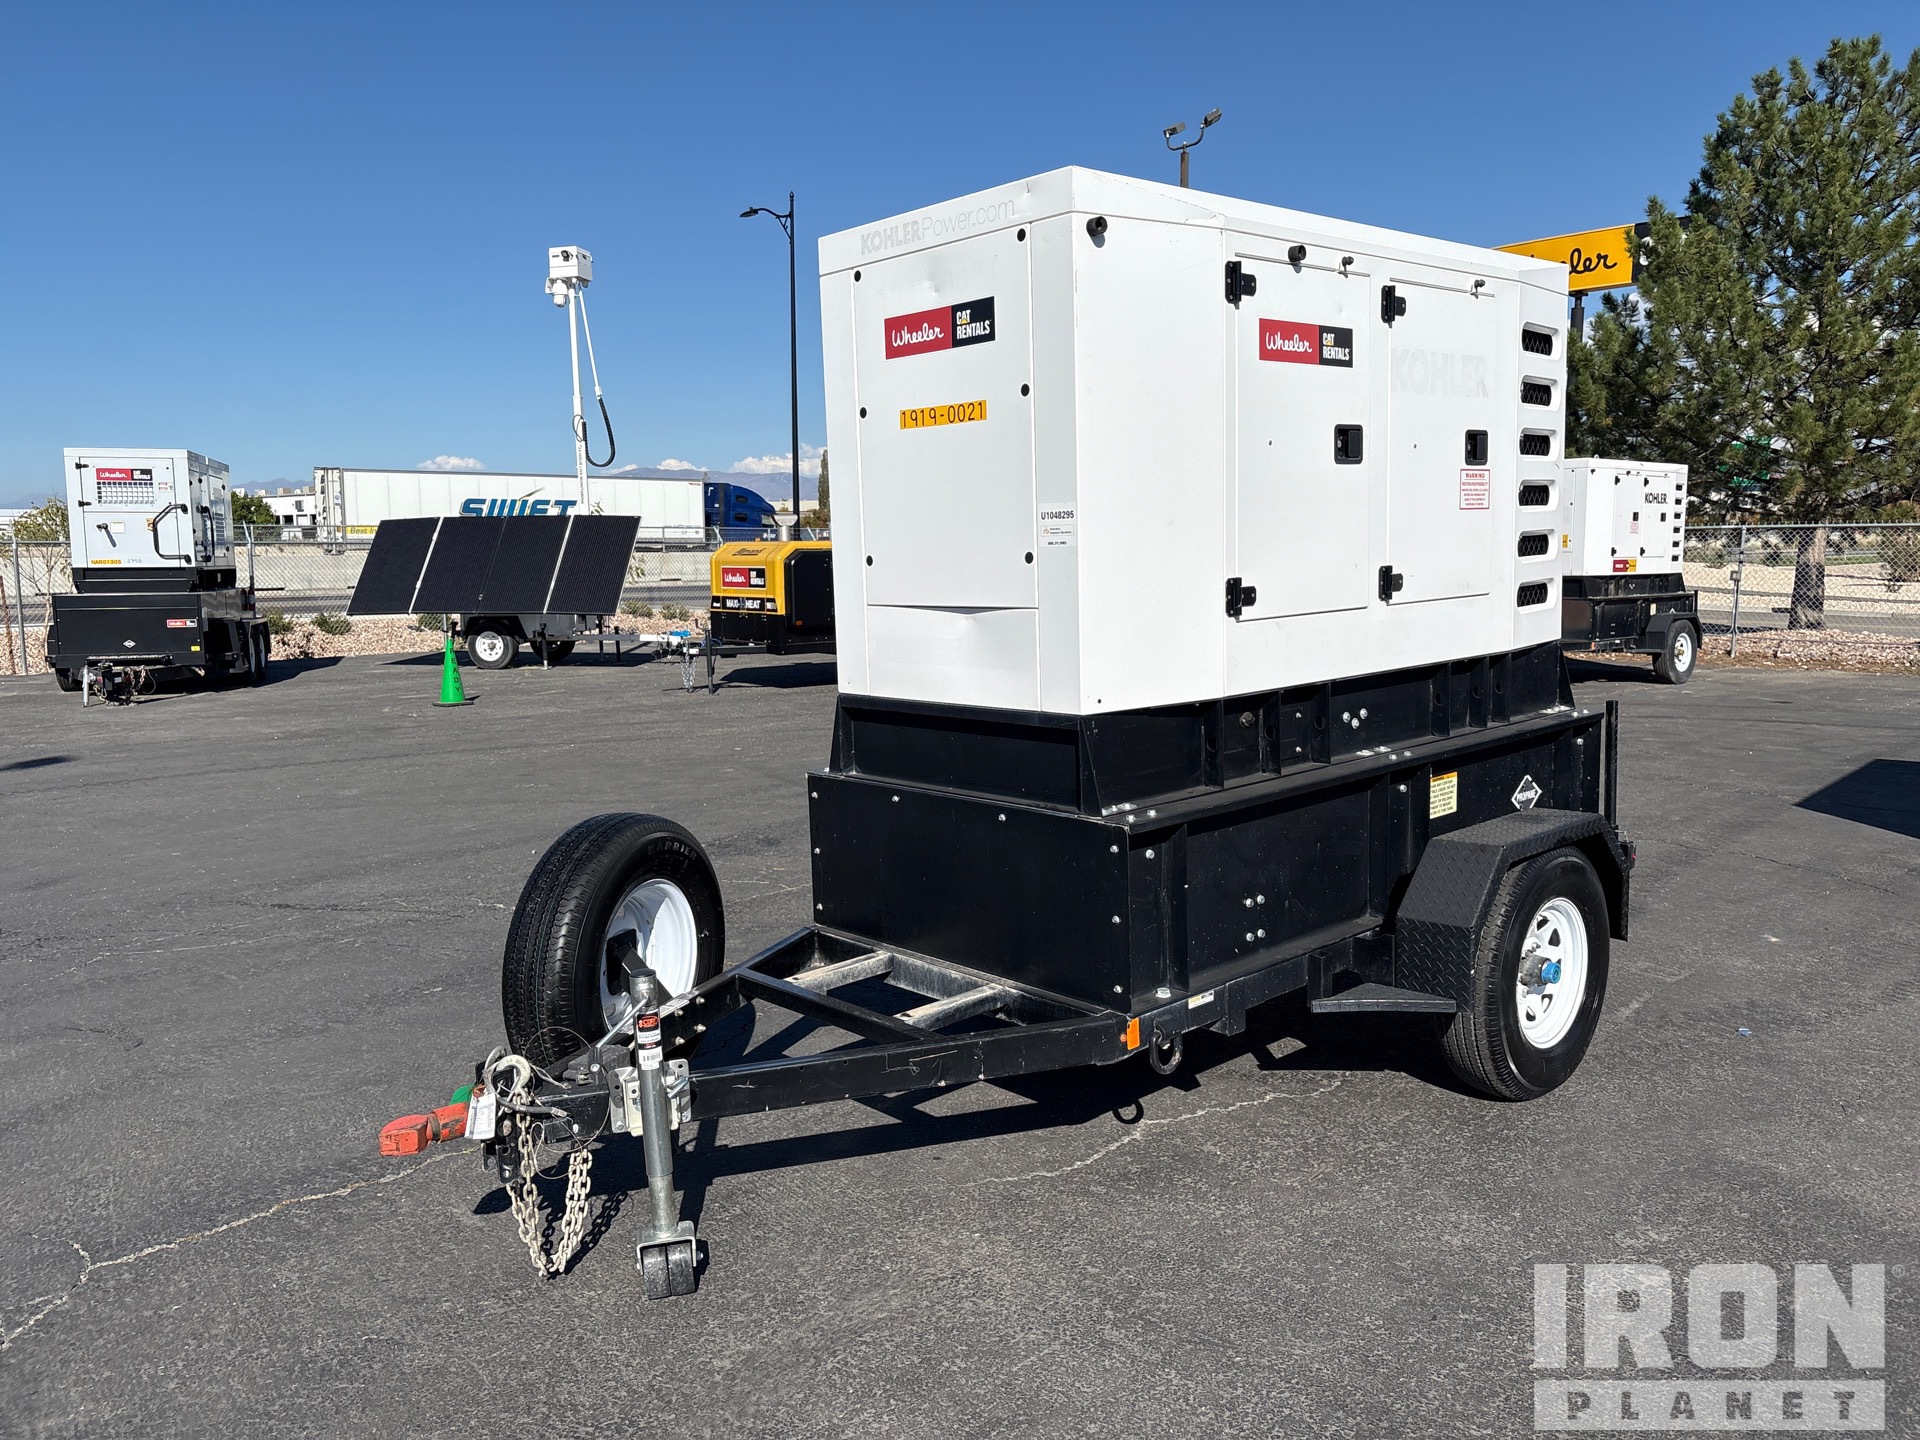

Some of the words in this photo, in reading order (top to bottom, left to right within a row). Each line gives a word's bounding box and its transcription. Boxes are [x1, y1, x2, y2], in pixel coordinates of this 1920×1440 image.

[860, 199, 1015, 256] KOHLERPower.com
[956, 309, 971, 325] CAT
[892, 321, 945, 348] Wheeler
[956, 319, 991, 340] RENTALS
[1265, 330, 1313, 353] Wheeler
[1322, 333, 1335, 346] CAT
[1322, 345, 1350, 361] RENTALS
[1391, 348, 1490, 398] KOHLER
[901, 401, 985, 428] 1919-0021
[459, 498, 577, 517] SWIFT
[1645, 493, 1667, 504] KOHLER
[1041, 510, 1074, 520] U1048295
[724, 571, 746, 583] Wheeler
[449, 647, 460, 693] READY
[1516, 788, 1536, 802] PROPANE
[647, 841, 698, 861] KARRIER
